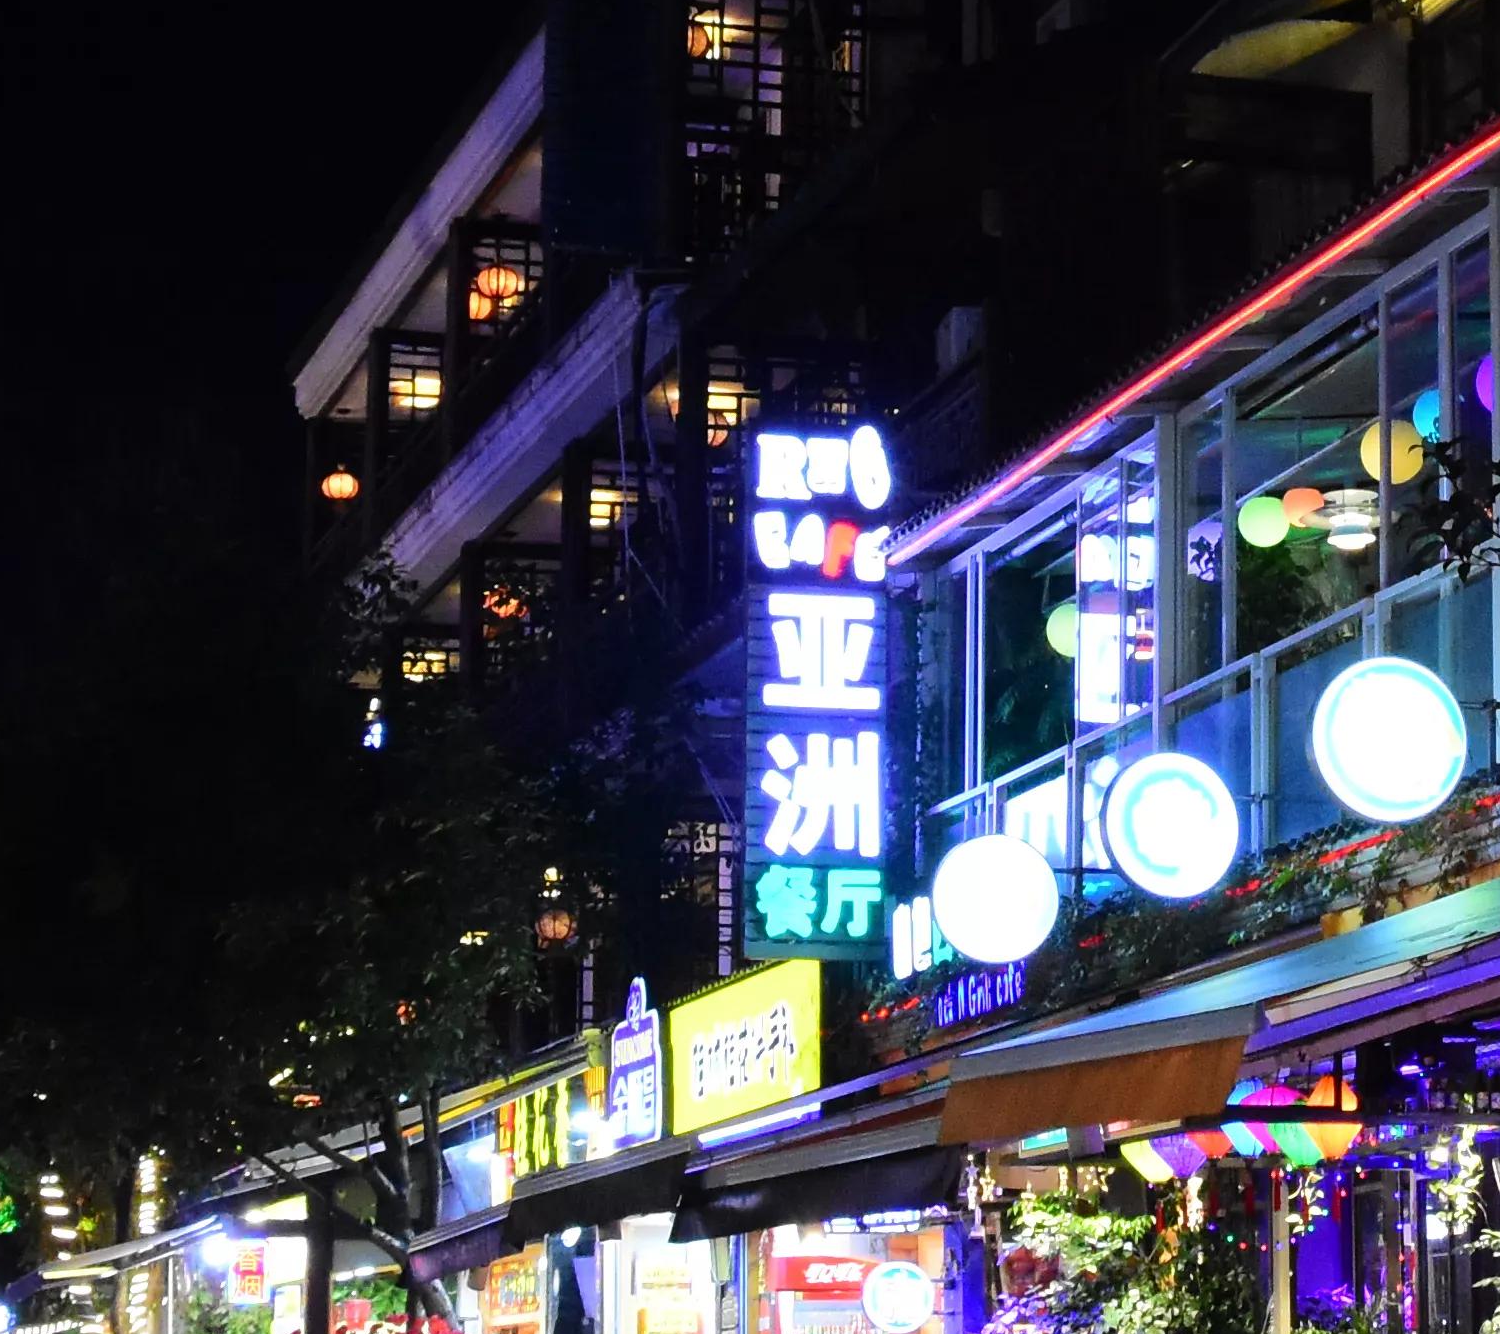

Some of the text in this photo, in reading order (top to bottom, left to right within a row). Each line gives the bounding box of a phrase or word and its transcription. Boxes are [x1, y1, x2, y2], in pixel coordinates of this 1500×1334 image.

[761, 592, 882, 858] 亚洲
[756, 863, 883, 940] 餐厅
[233, 1245, 263, 1300] 香烟
